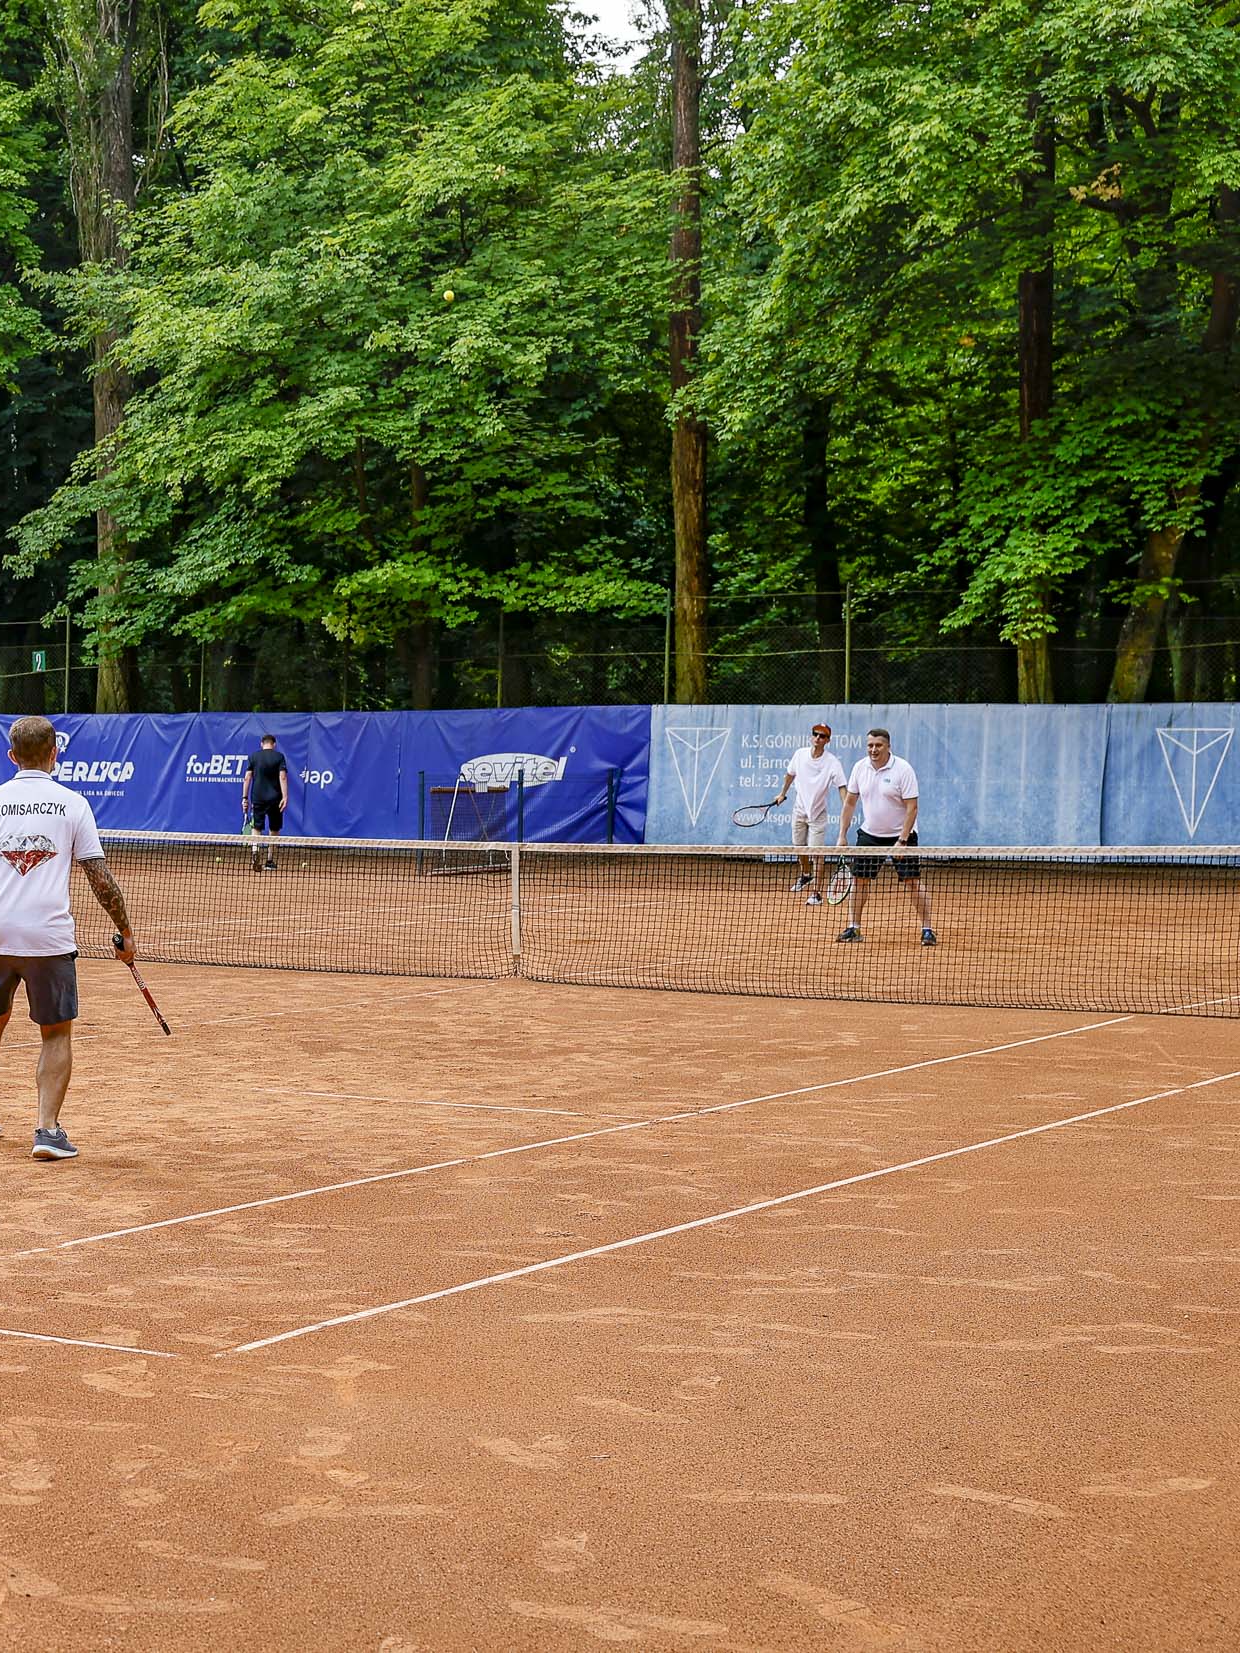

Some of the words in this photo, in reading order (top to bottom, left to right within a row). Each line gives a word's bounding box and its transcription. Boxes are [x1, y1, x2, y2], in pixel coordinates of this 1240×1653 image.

[35, 653, 42, 672] 2
[186, 754, 249, 775] forBET
[460, 756, 568, 782] sevitel
[740, 755, 755, 769] ul.
[764, 774, 779, 787] 32
